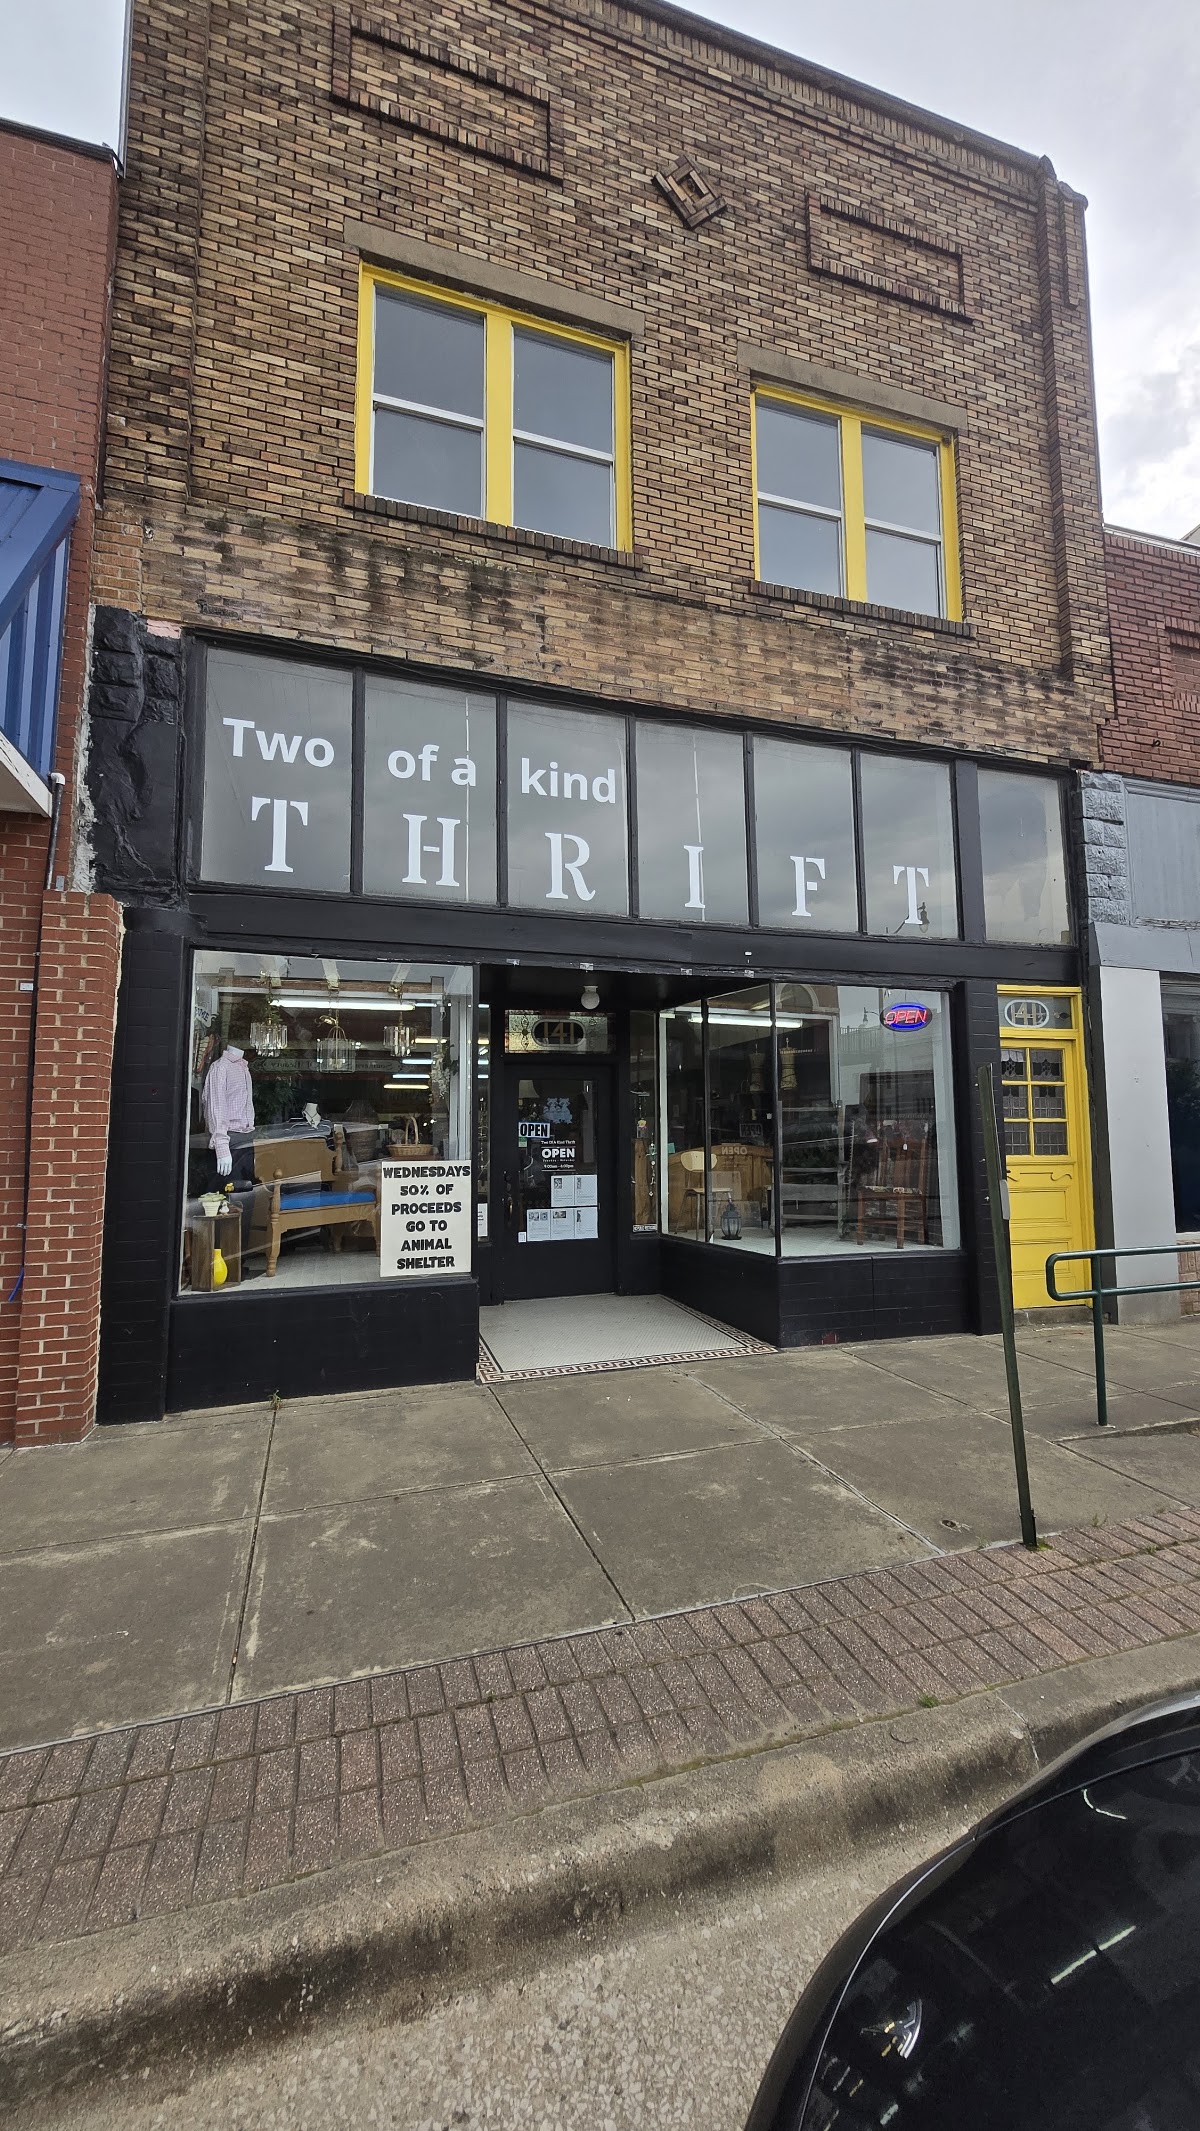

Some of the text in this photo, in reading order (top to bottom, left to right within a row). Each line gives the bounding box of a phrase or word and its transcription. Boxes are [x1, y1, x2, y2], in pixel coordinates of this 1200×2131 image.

[222, 717, 616, 804] Two of a kind
[885, 1010, 927, 1024] OPEN
[543, 1022, 575, 1045] 141
[519, 1123, 548, 1137] OPEN
[541, 1148, 575, 1158] OPEN
[383, 1165, 471, 1179] WEDNESDAYS
[400, 1183, 454, 1196] 50% OF
[391, 1201, 462, 1216] PROCEEDS
[405, 1219, 448, 1232] GO TO
[400, 1237, 453, 1252] ANIMAL
[396, 1255, 456, 1270] SHELTER
